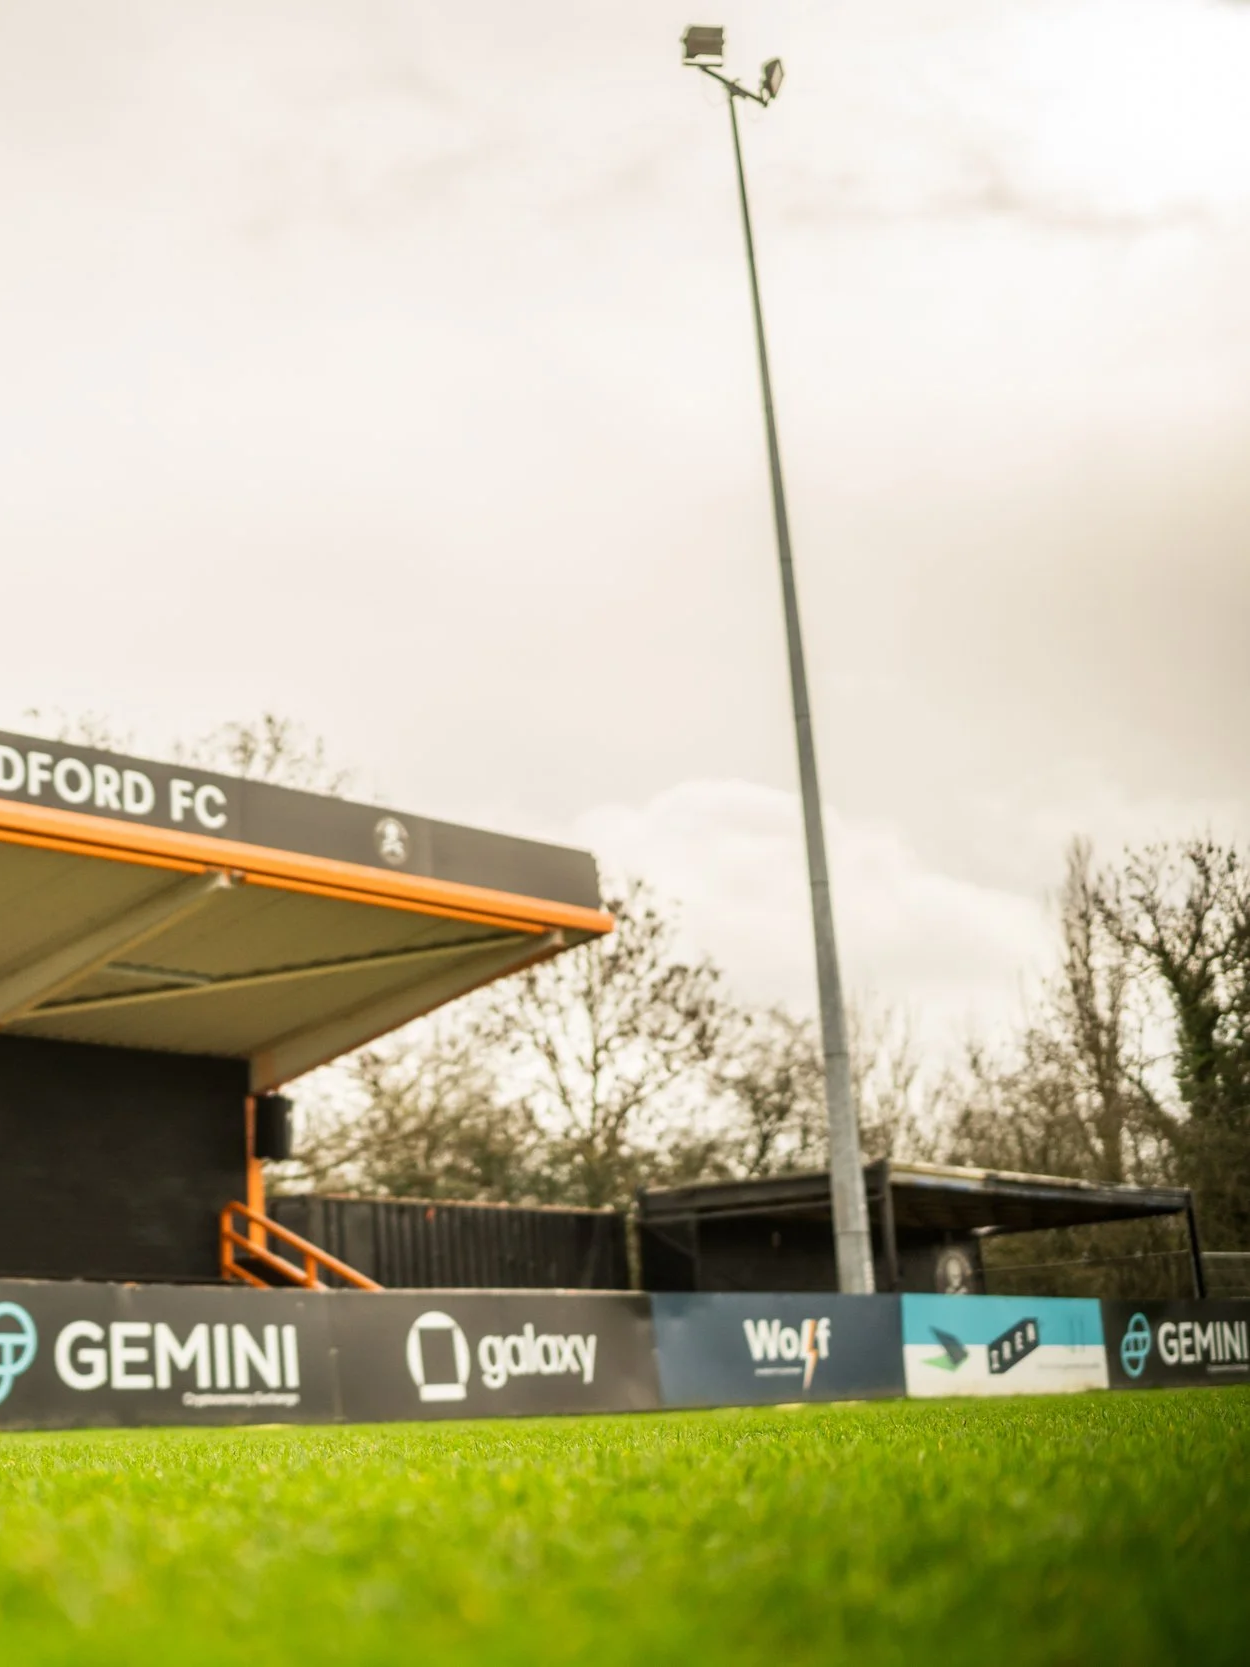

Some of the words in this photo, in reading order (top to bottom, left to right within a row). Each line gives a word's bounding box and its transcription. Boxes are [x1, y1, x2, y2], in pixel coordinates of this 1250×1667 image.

[169, 778, 227, 829] FC
[54, 1320, 301, 1391] GEMINI
[477, 1322, 597, 1390] galaxy
[742, 1317, 832, 1390] Wolf
[1157, 1320, 1249, 1365] GEMINI
